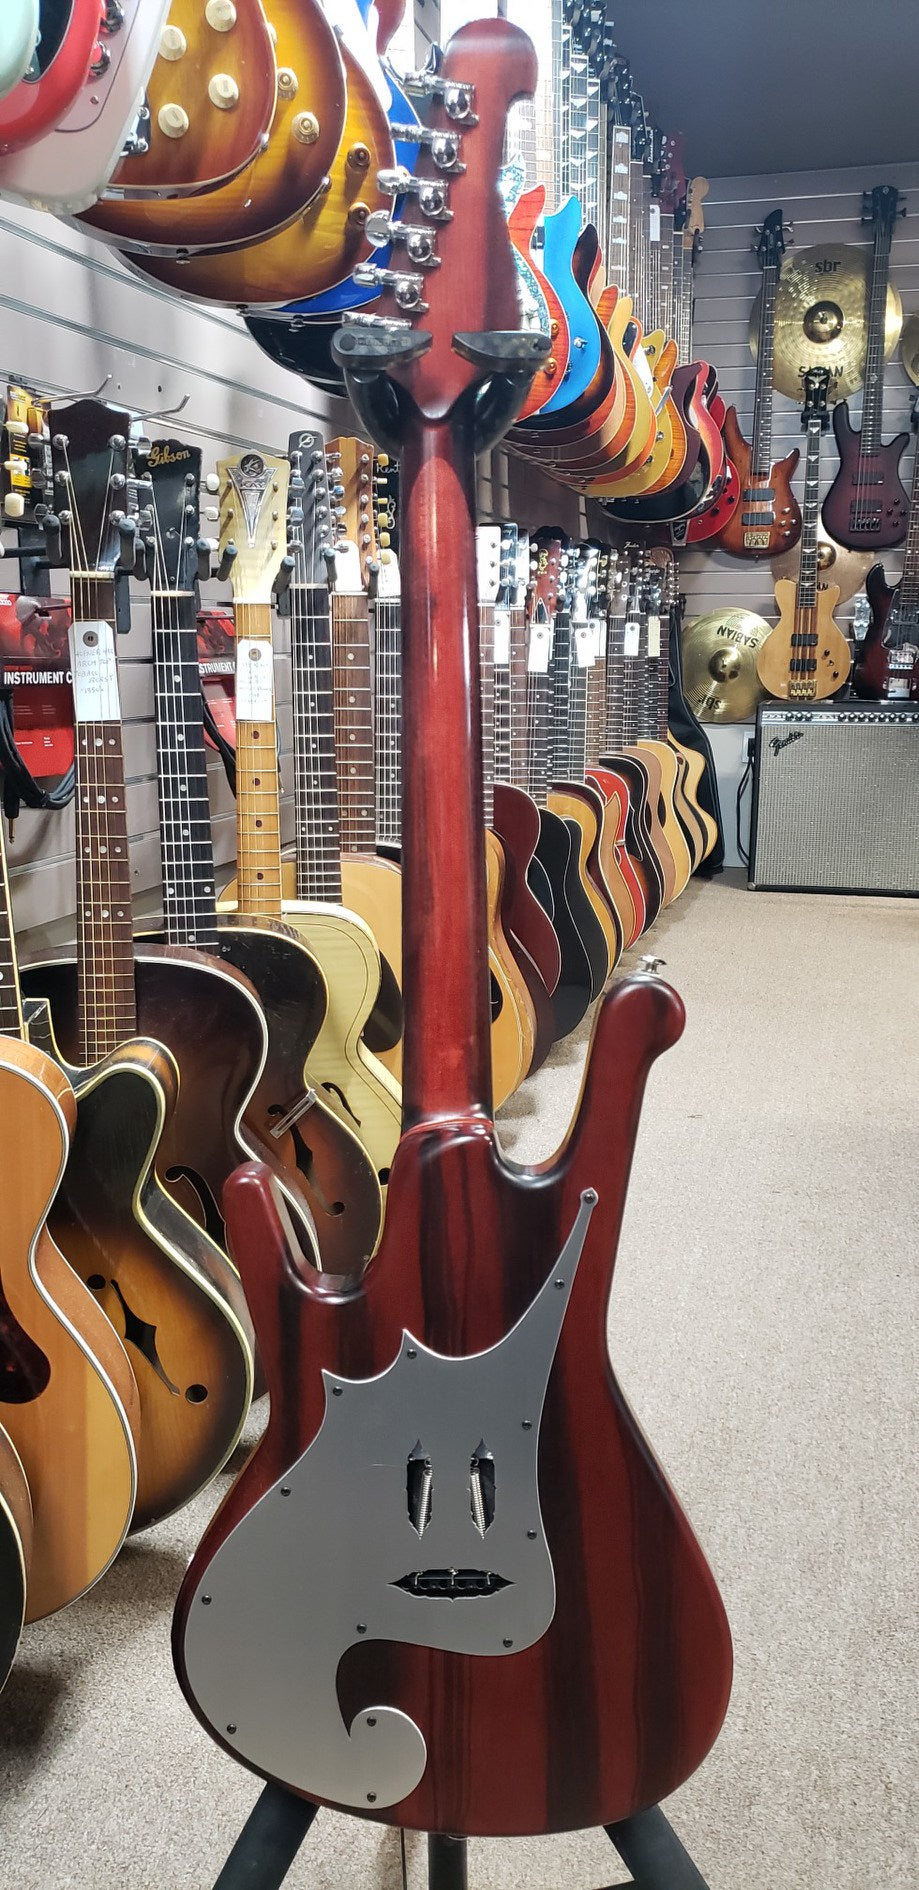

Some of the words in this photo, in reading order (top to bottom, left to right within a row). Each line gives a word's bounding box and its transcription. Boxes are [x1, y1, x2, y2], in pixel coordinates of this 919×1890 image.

[814, 260, 841, 272] sbr
[146, 445, 191, 467] Gibson
[716, 625, 759, 648] SABIAN
[4, 671, 64, 685] INSTRUMENT
[769, 731, 804, 756] Fender
